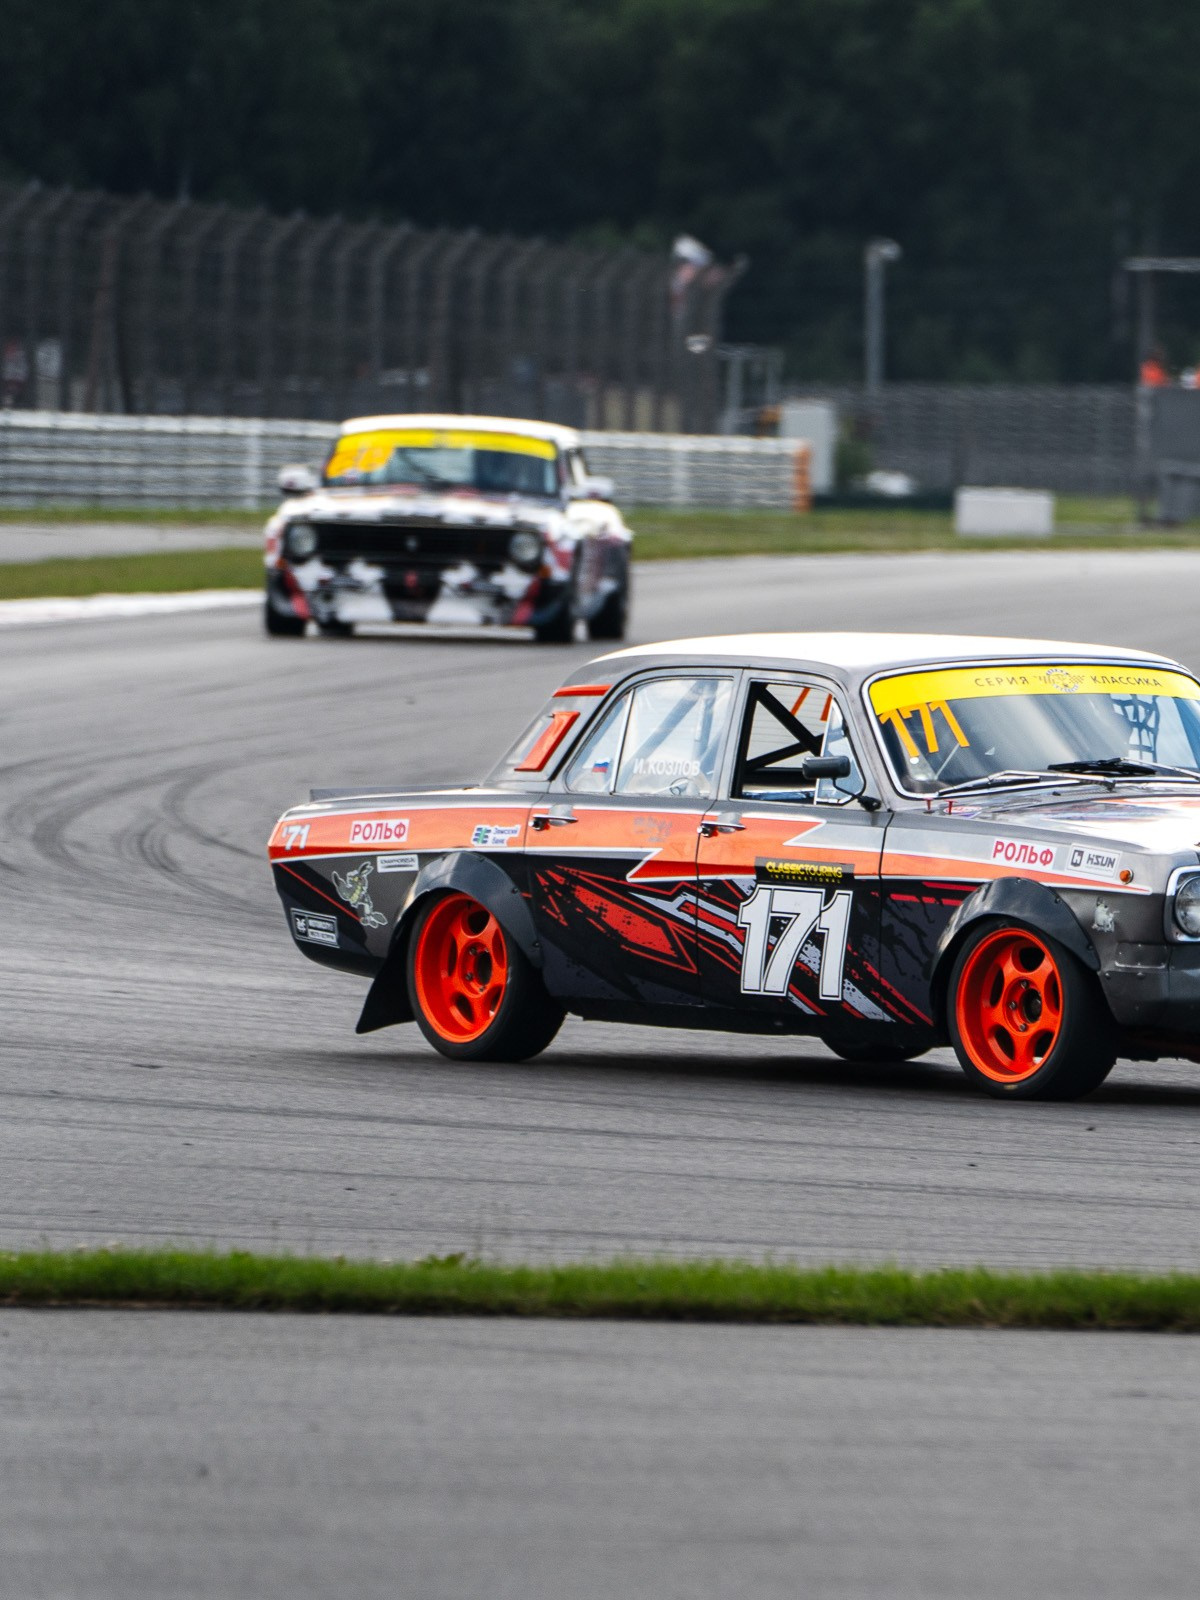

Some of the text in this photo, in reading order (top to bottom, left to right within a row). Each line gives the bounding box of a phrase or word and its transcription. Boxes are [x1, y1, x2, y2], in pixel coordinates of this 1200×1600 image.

[974, 676, 1030, 687] СЕРИЯ
[1090, 675, 1163, 688] КЛАССИКА
[879, 699, 970, 758] 171
[351, 822, 407, 841] РОЛЬФ
[992, 840, 1054, 867] РОЛЬФ
[1085, 853, 1117, 869] HSUN
[737, 883, 854, 1001] 171
